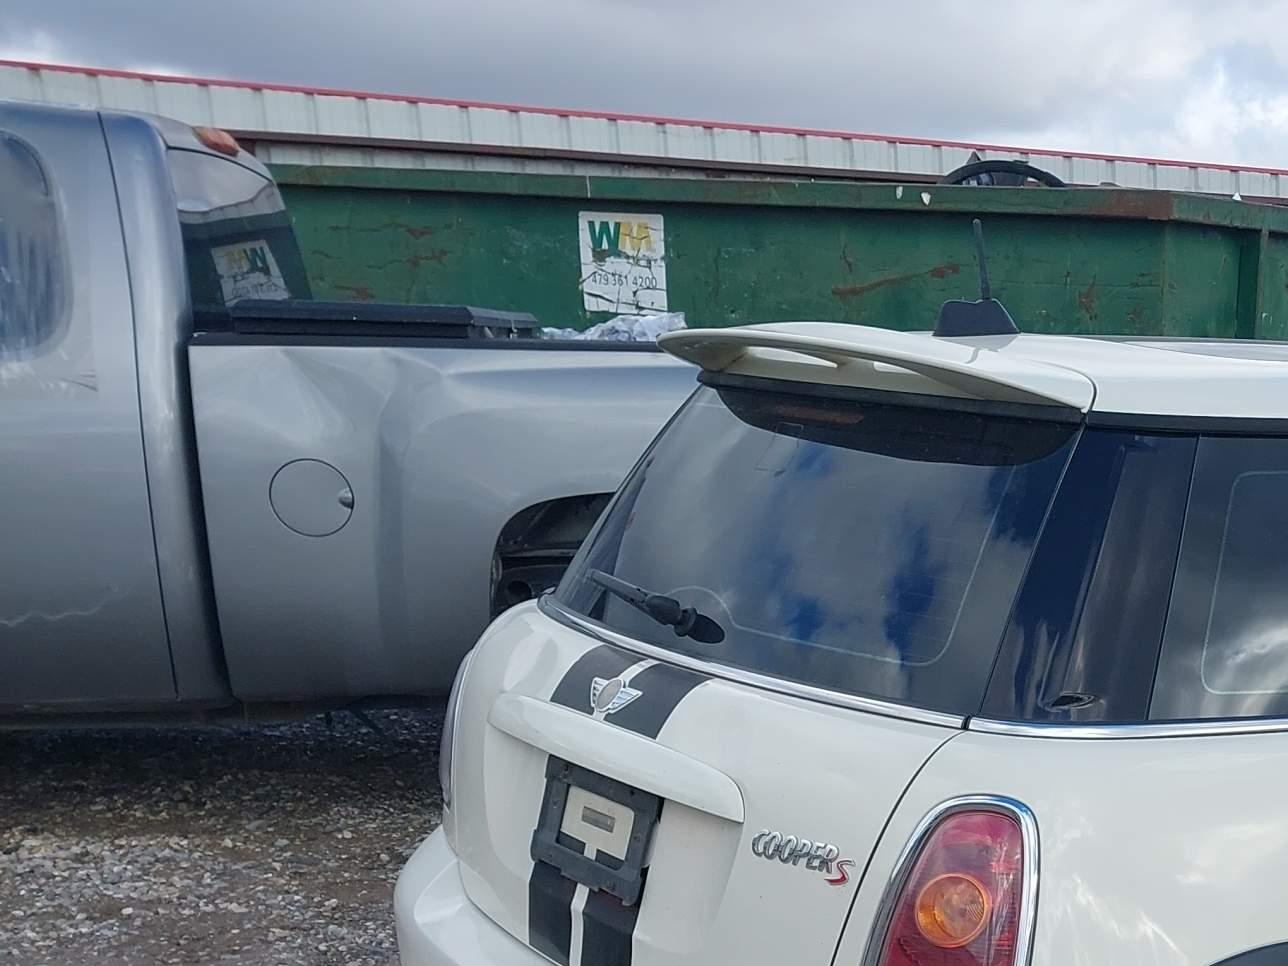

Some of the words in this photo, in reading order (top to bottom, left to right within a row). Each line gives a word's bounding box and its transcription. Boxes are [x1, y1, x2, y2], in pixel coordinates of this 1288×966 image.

[591, 273, 609, 286] 479
[611, 273, 629, 287] 361
[632, 275, 658, 289] 4200
[752, 829, 840, 874] COOPER
[824, 858, 857, 886] S
